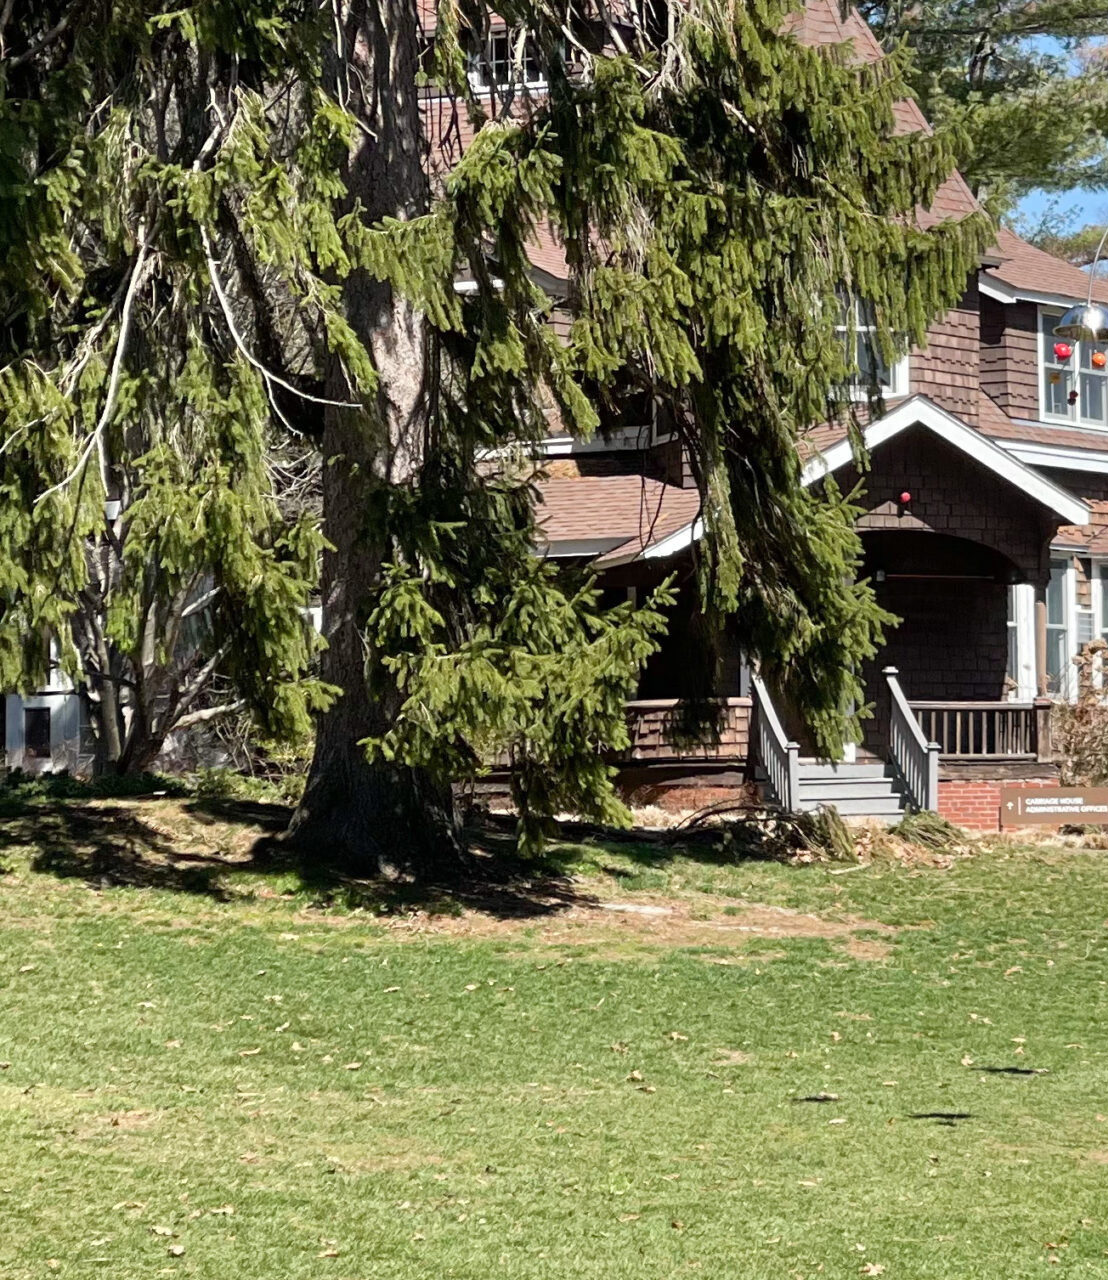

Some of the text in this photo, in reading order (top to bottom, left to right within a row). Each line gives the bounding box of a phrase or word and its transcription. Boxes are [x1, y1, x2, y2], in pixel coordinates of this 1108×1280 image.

[1025, 797, 1083, 805] CARRIAGE HOUSE
[1025, 805, 1108, 813] ADMINISTRATIVE OFFICES
